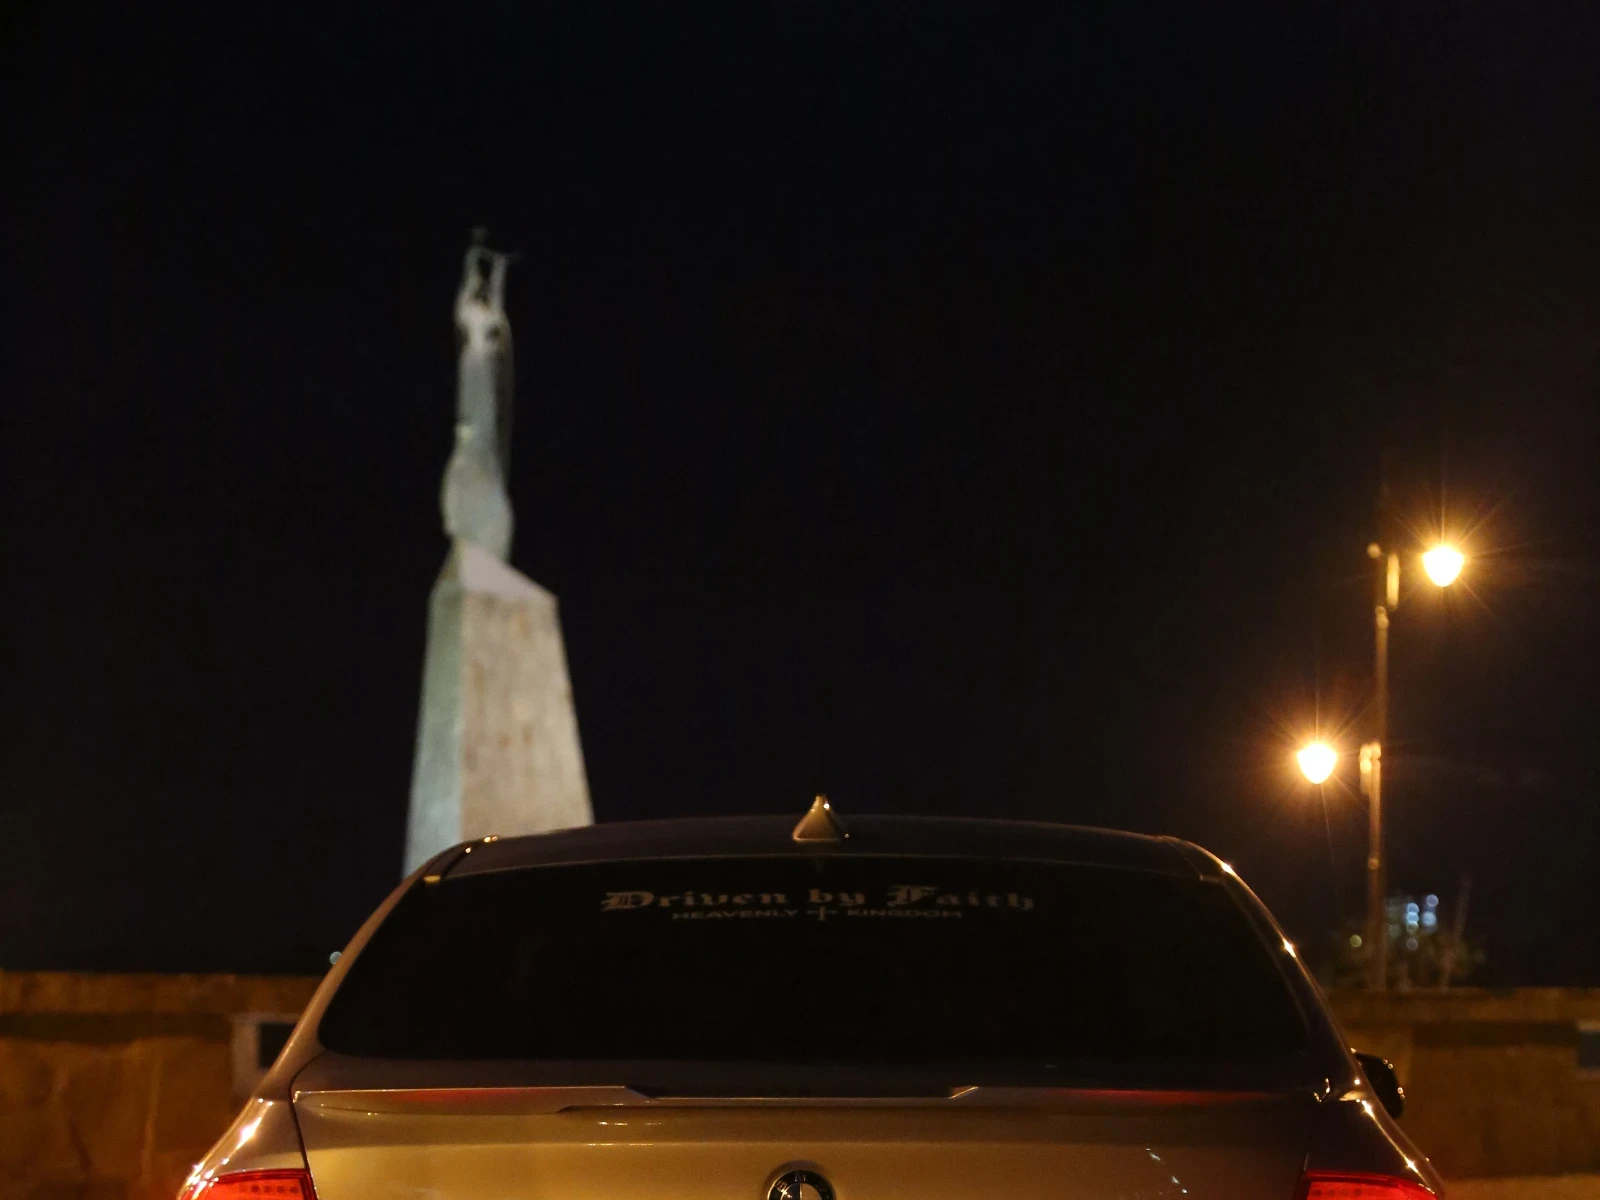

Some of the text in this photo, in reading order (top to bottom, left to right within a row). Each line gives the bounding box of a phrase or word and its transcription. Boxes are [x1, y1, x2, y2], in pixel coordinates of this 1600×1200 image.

[601, 884, 1035, 912] Driven by Faith
[672, 908, 963, 920] HEAVENLY KINGDOM
